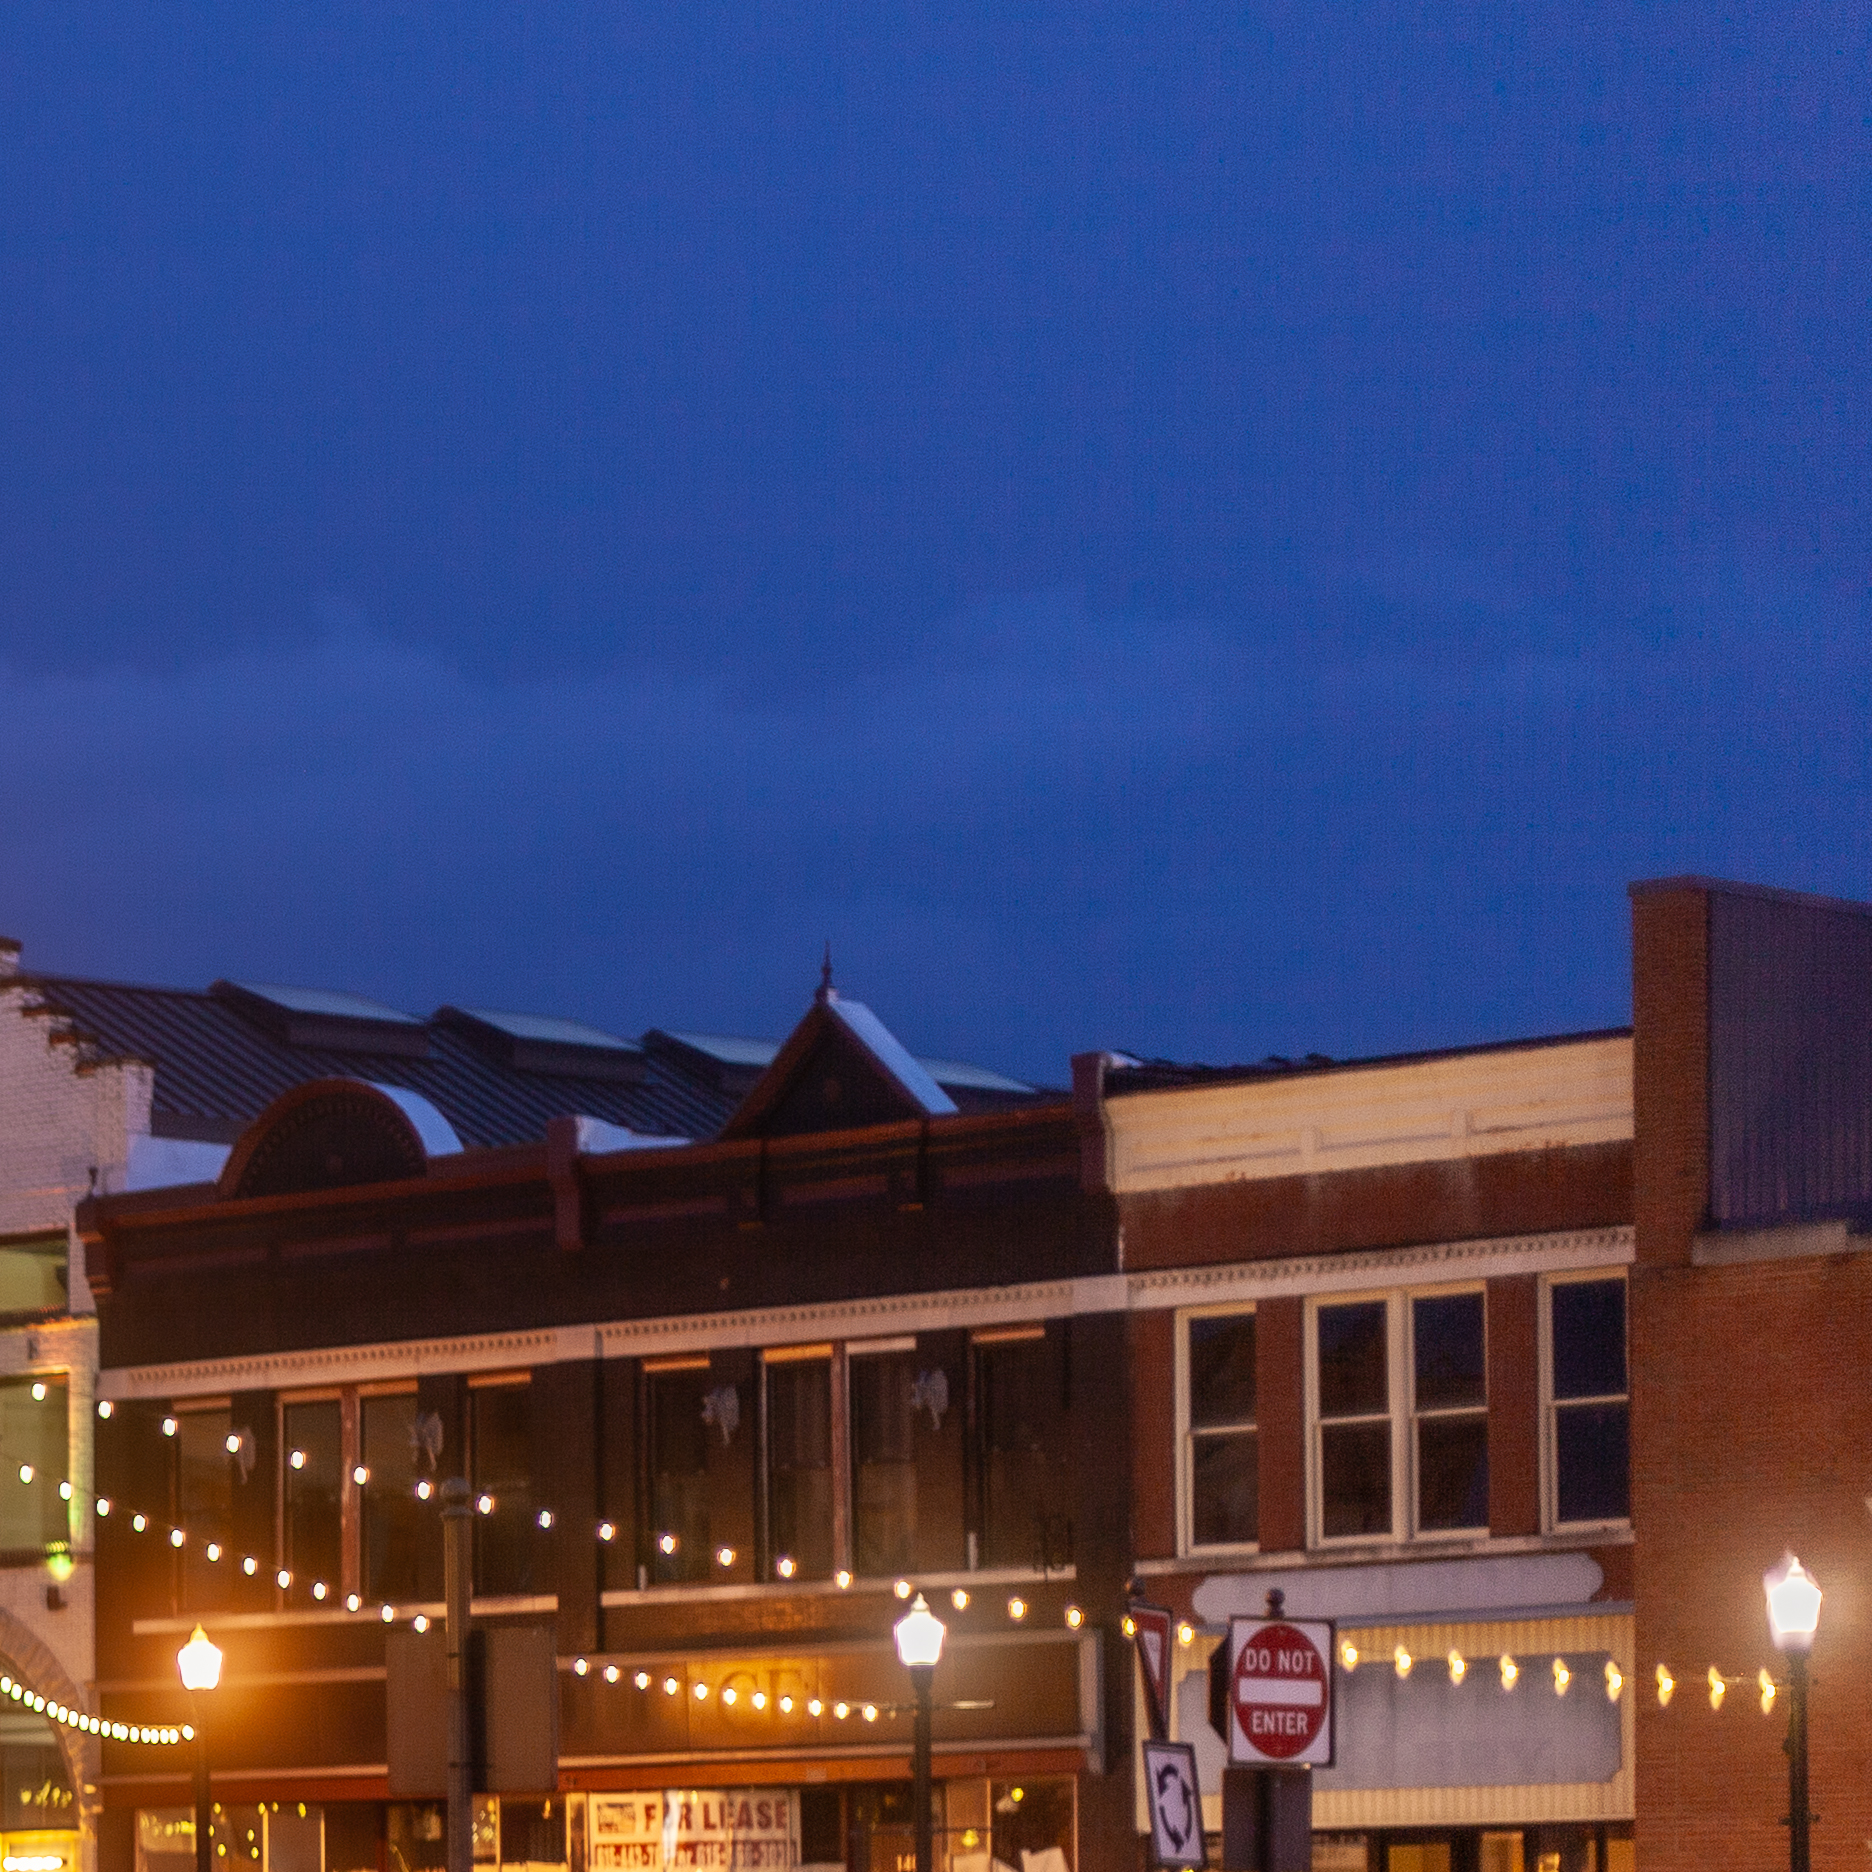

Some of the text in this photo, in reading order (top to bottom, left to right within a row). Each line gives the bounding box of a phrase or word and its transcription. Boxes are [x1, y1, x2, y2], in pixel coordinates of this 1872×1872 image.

[1245, 1648, 1315, 1674] DO NOT
[1251, 1710, 1309, 1736] ENTER
